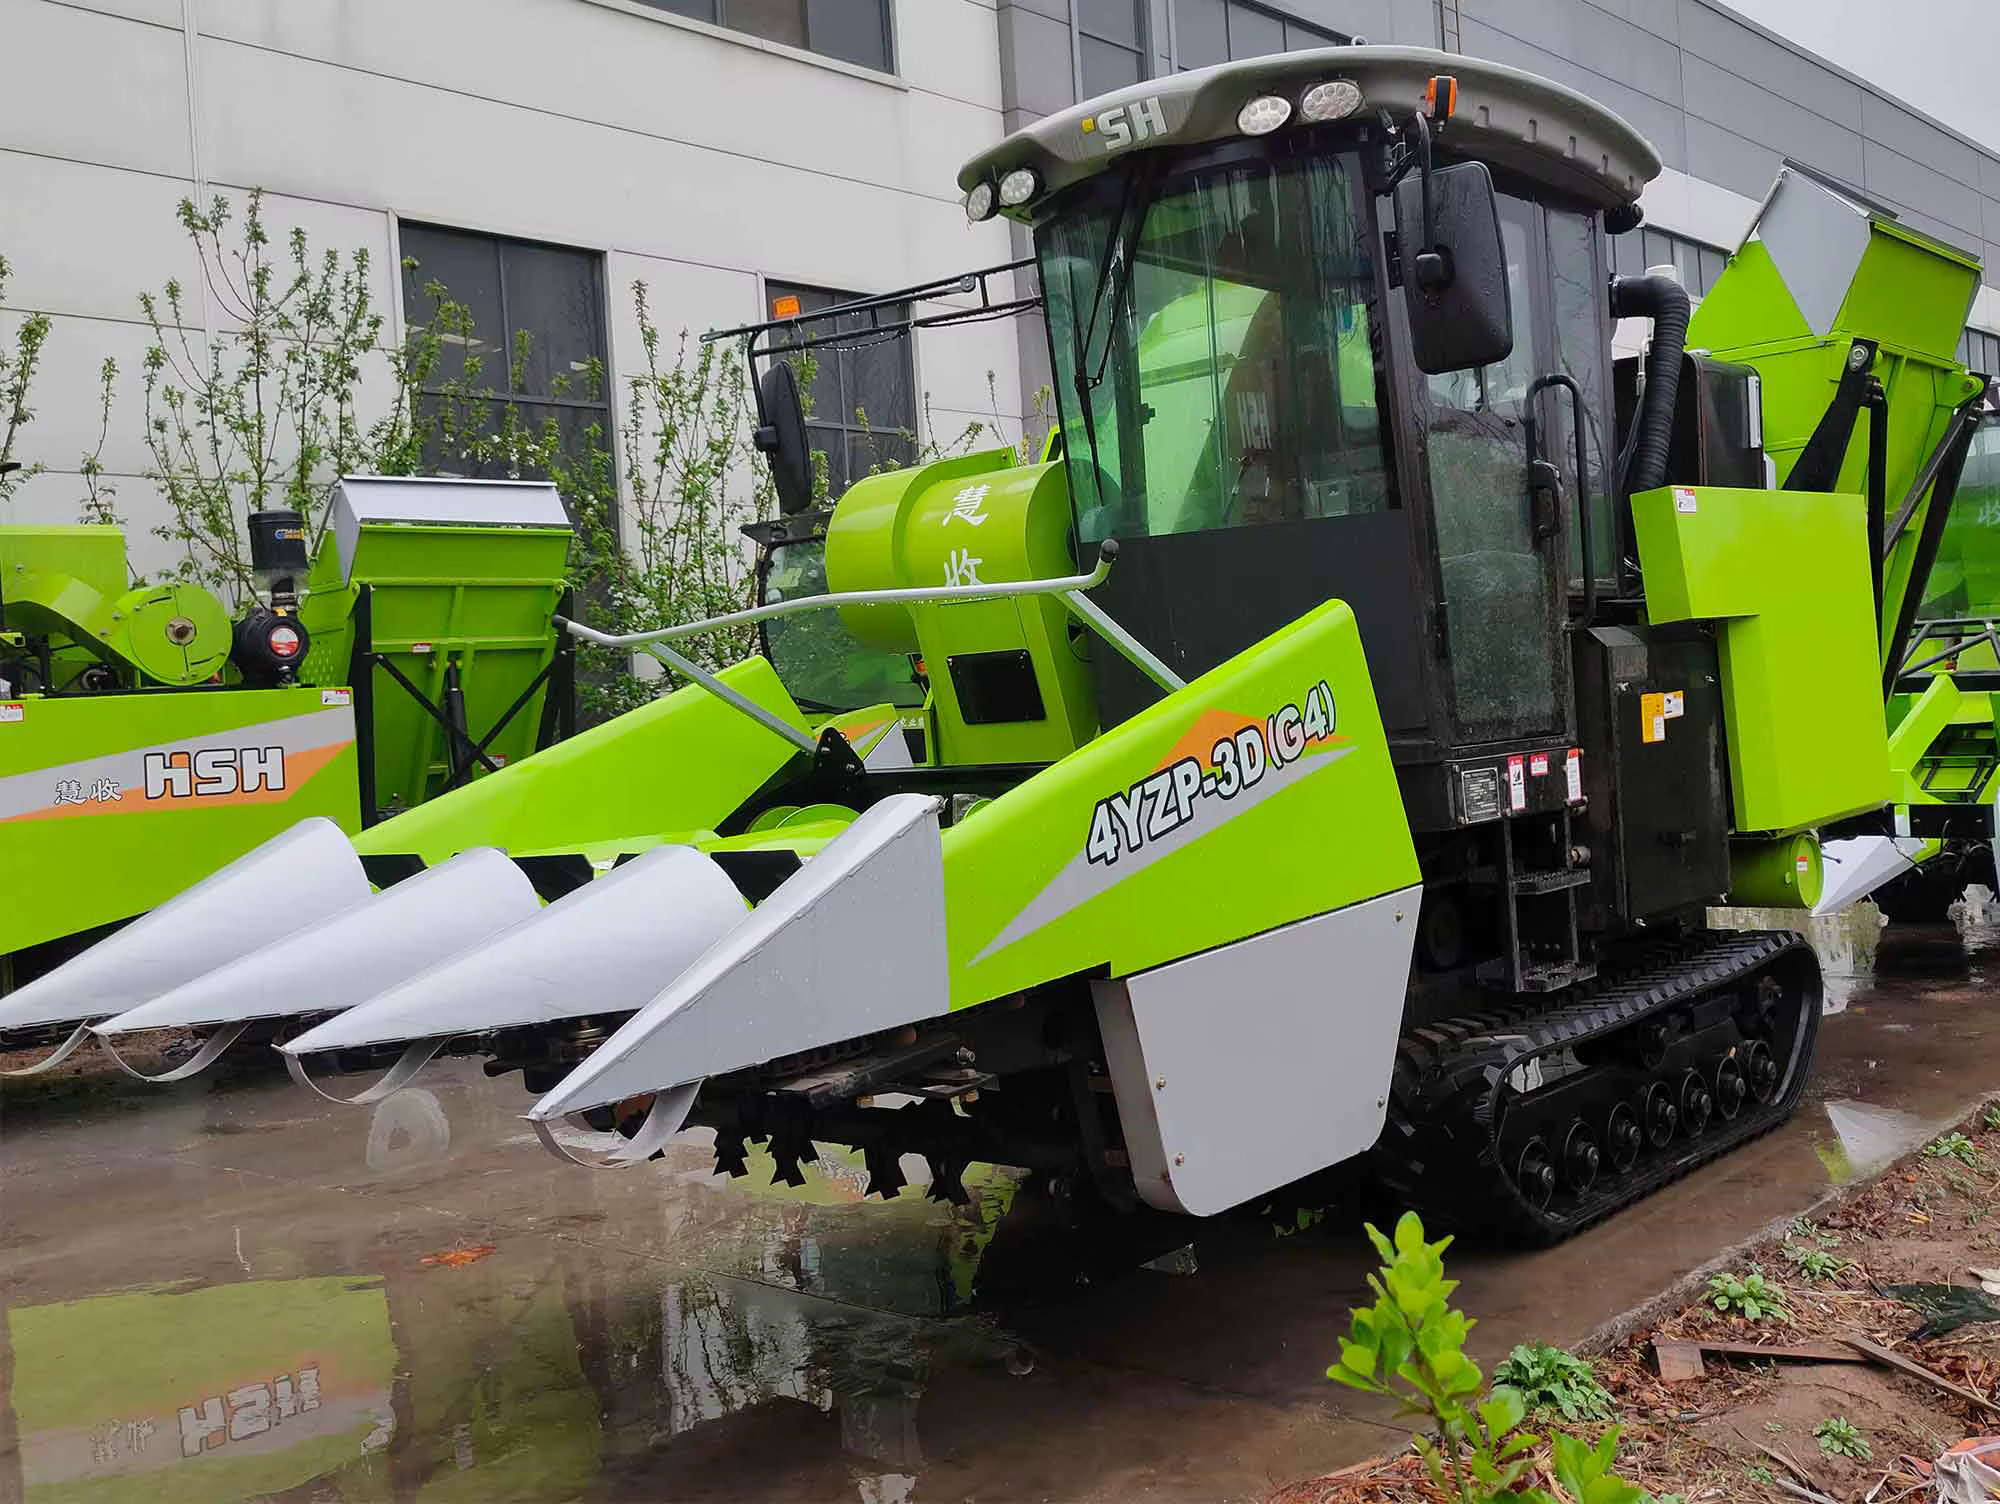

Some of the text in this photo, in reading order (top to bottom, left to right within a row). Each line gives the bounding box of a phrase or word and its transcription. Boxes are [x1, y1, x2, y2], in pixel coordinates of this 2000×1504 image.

[942, 483, 992, 587] 慧收
[54, 777, 123, 805] 慧收
[143, 746, 287, 800] HSH
